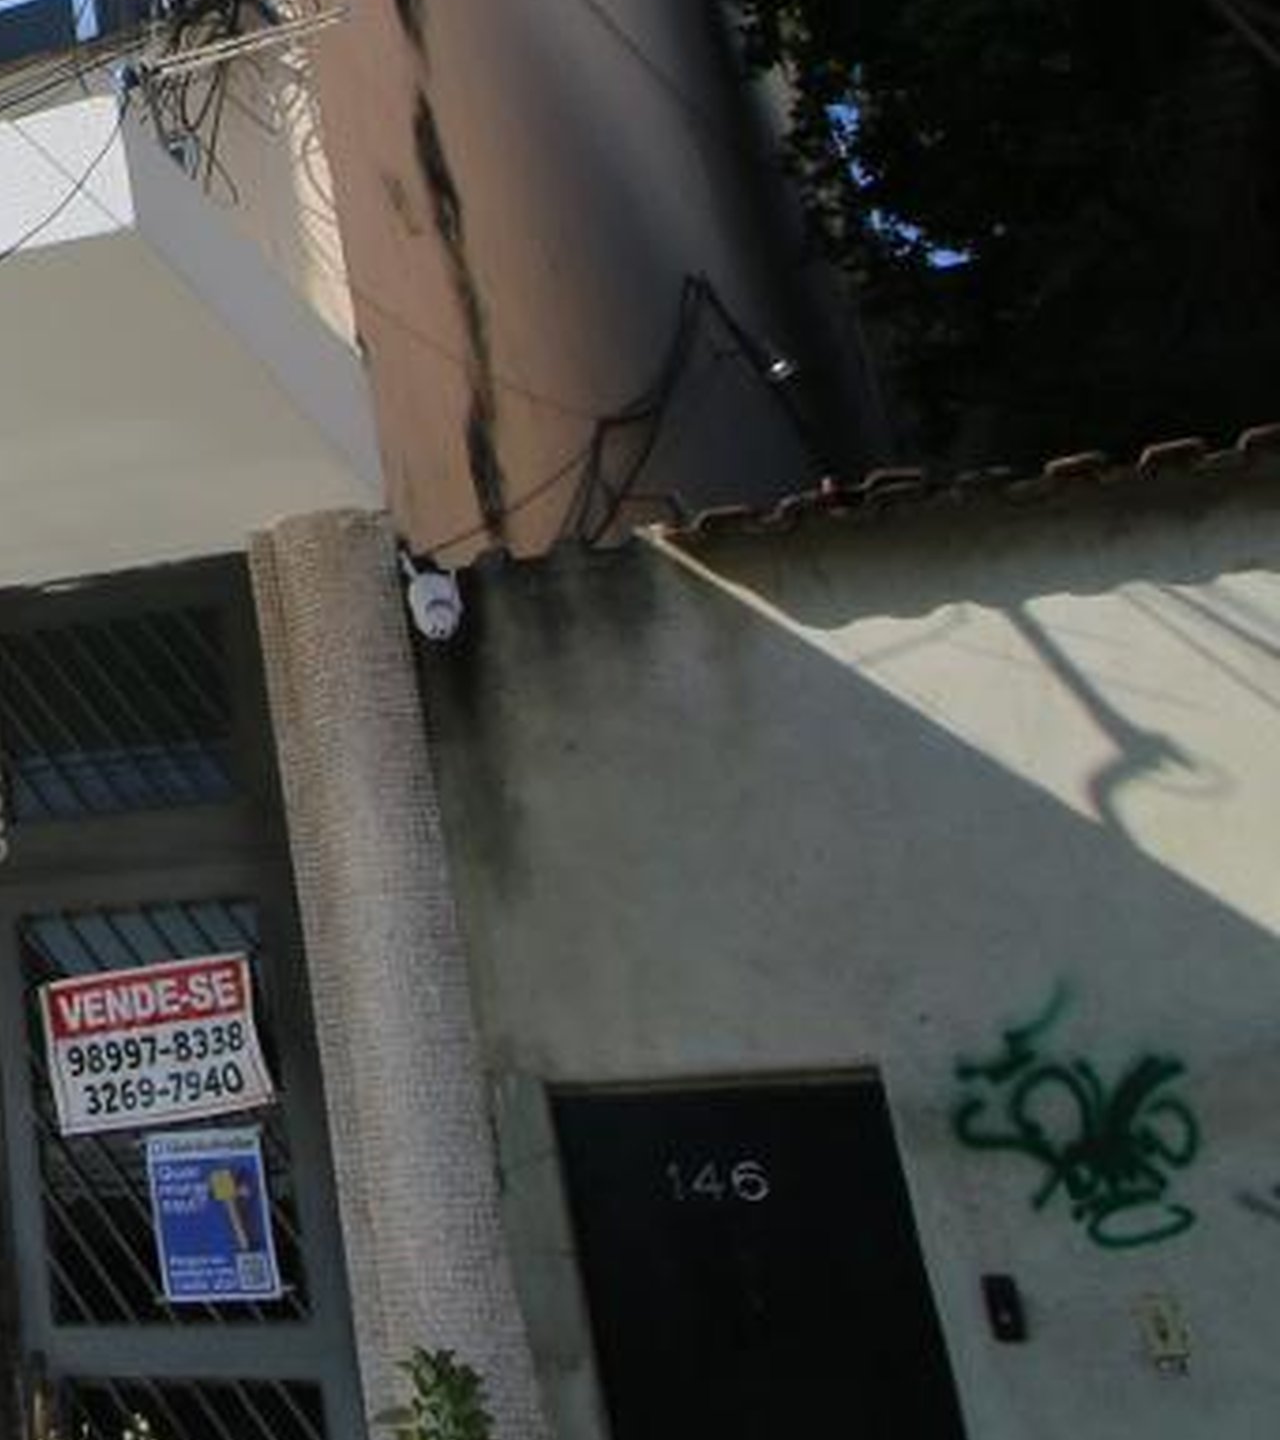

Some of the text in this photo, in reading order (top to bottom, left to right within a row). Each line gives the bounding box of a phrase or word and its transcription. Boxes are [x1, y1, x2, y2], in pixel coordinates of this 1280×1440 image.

[57, 969, 237, 1032] VENDE-SE
[68, 1021, 244, 1077] 98997-8338
[83, 1061, 244, 1116] 3269-7940
[666, 1160, 772, 1202] 146
